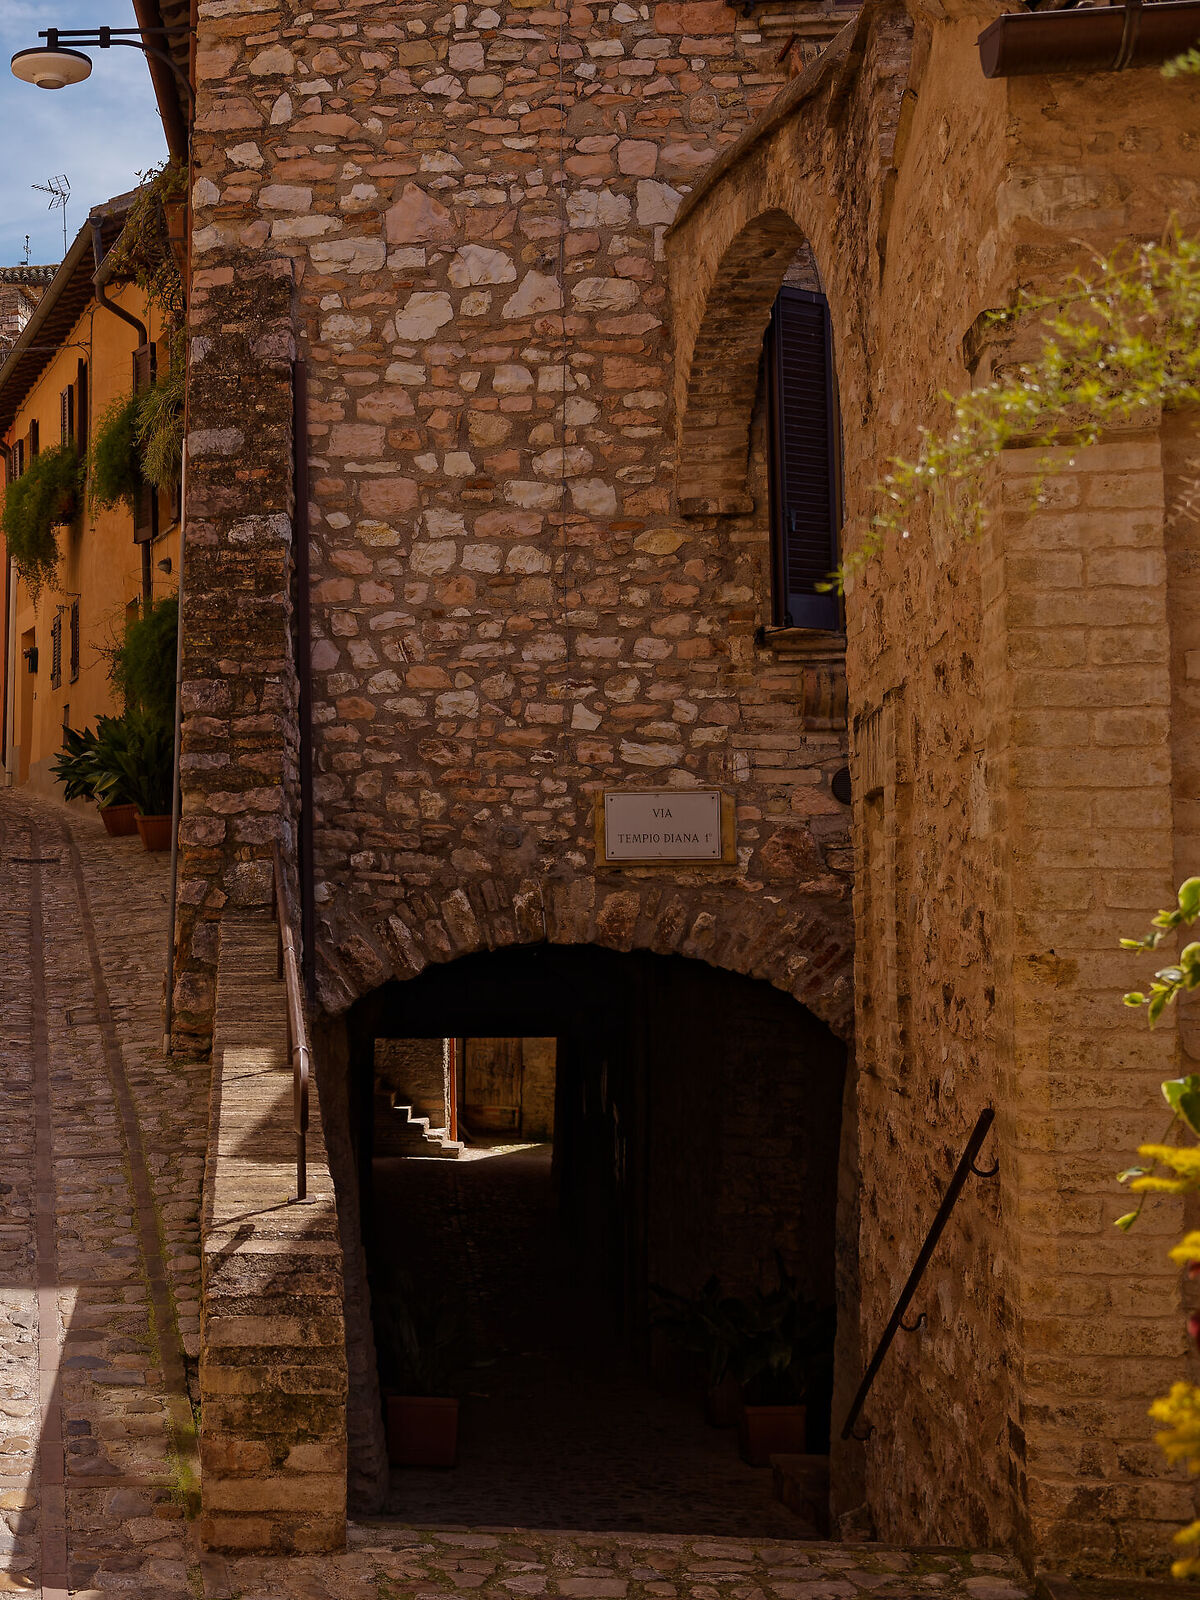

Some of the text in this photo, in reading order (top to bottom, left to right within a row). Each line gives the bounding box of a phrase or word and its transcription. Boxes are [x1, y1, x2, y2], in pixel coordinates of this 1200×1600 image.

[652, 808, 673, 818] VIA
[618, 833, 661, 843] TEMPIO
[663, 833, 699, 843] DIANA
